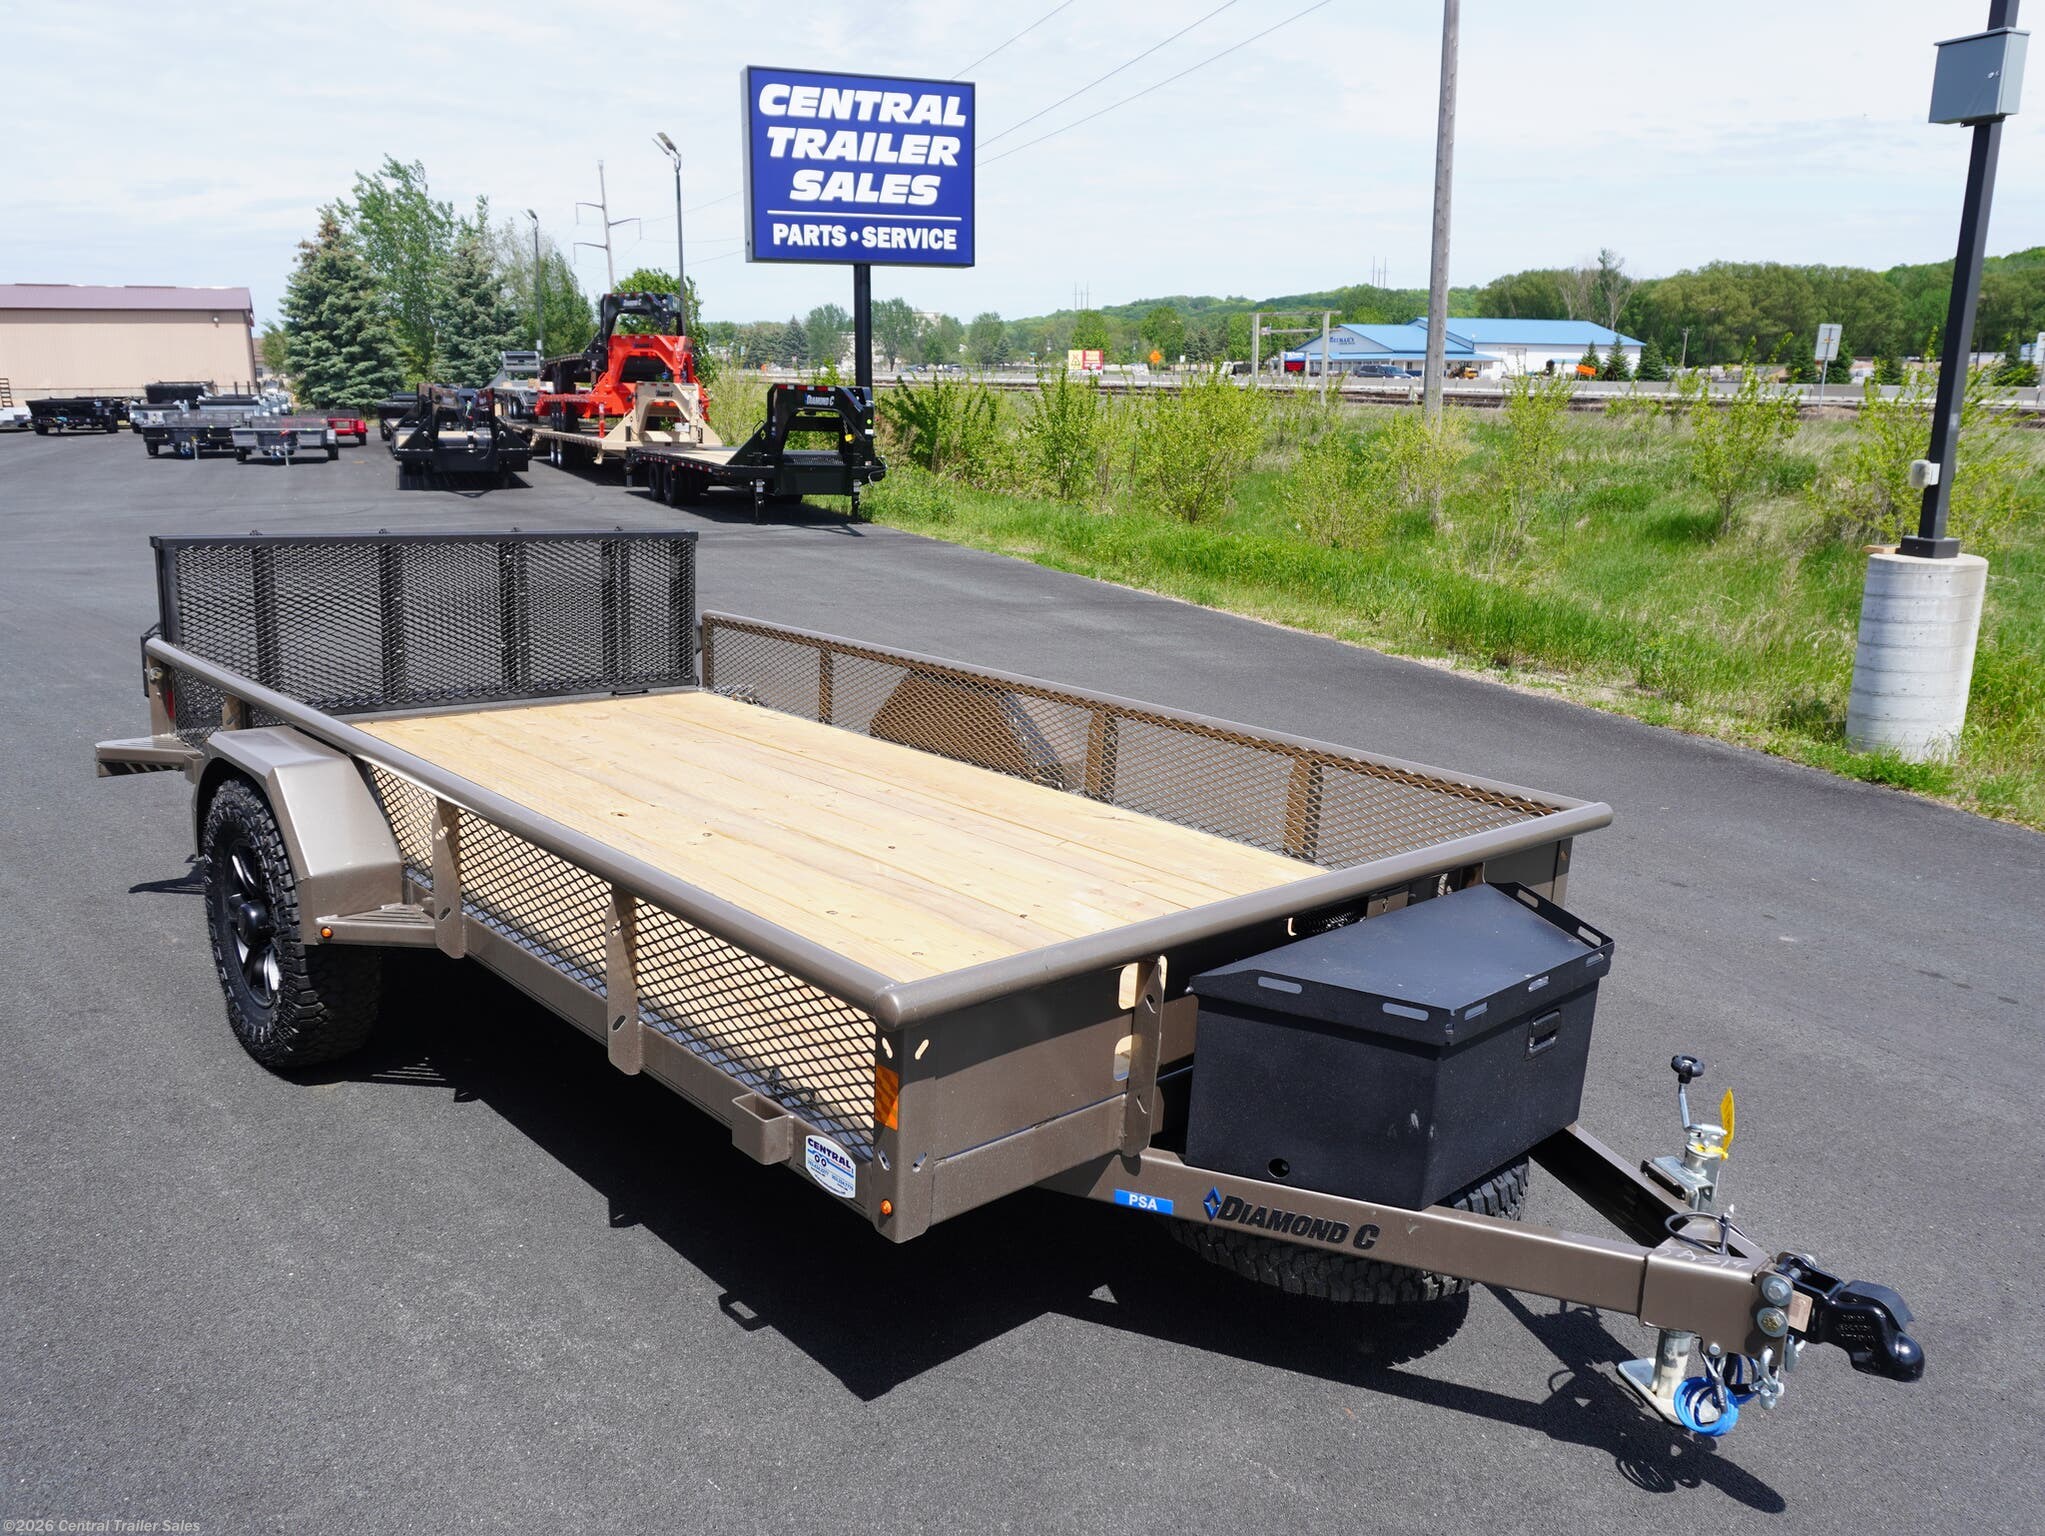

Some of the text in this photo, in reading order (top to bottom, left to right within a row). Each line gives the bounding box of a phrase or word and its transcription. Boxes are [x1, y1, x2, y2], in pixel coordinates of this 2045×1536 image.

[759, 83, 967, 127] CENTRAL
[767, 126, 961, 166] TRAILER
[789, 169, 941, 206] SALES
[773, 223, 957, 250] PARTS SERVICE
[807, 1137, 851, 1169] CENTRAL
[1128, 1193, 1158, 1211] PSA
[1217, 1195, 1380, 1250] DIAMOND C
